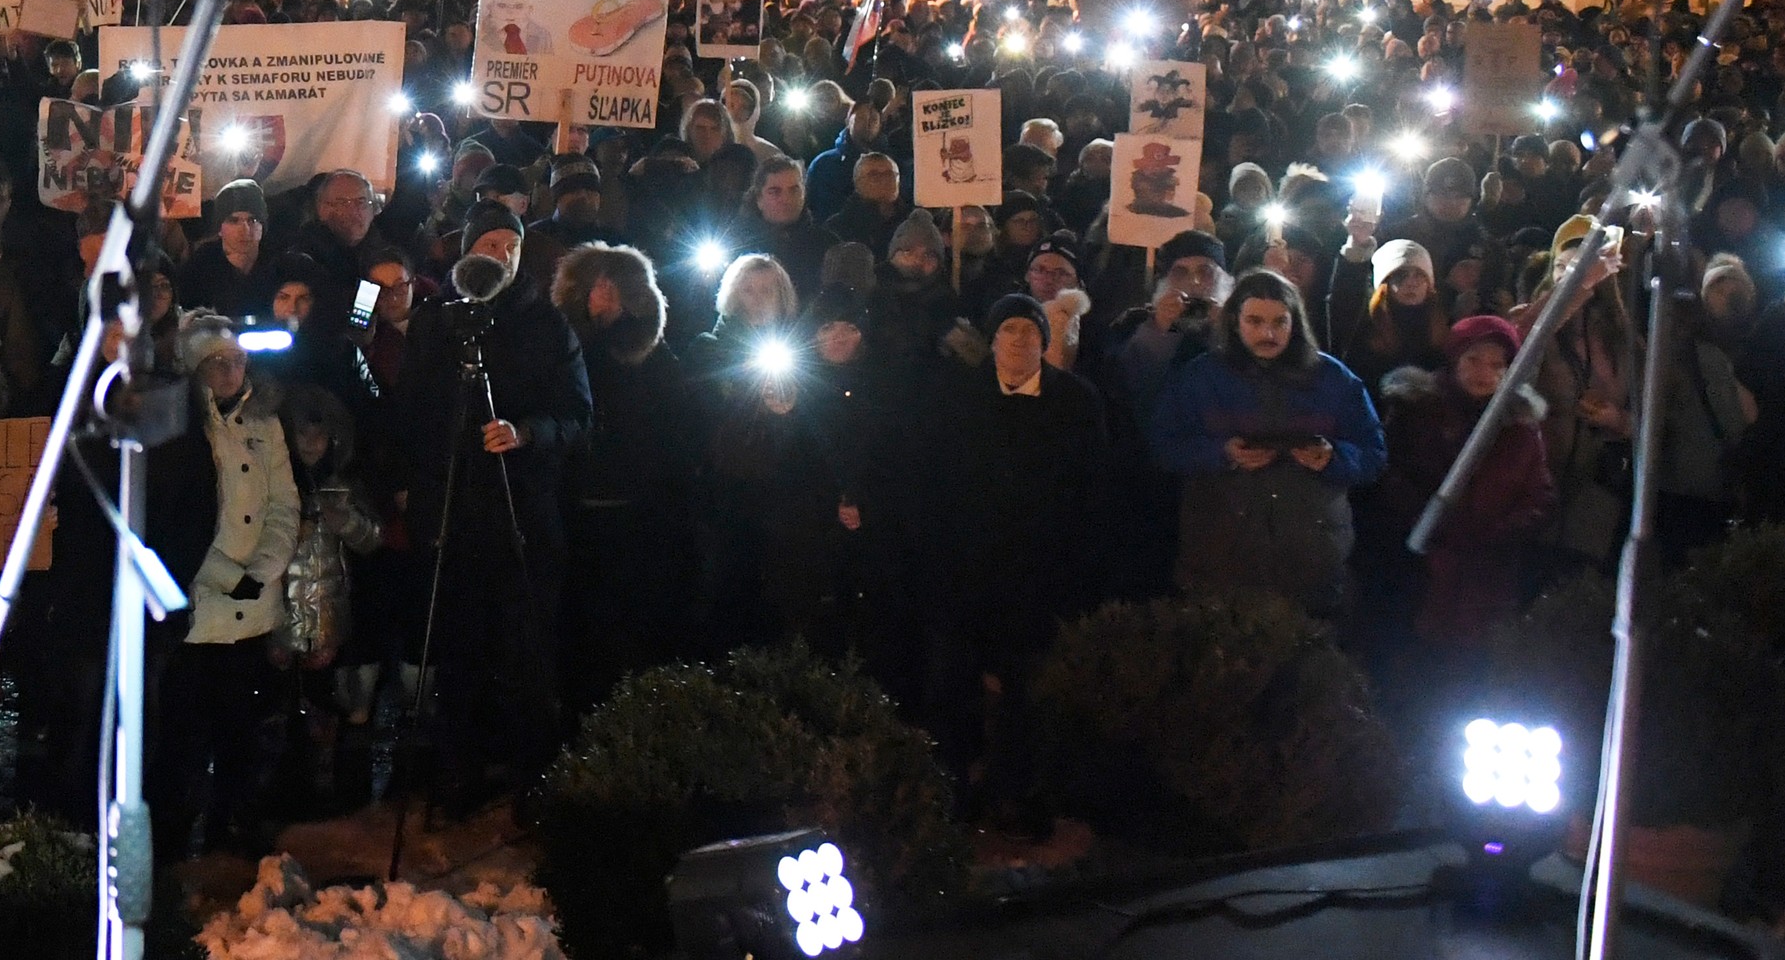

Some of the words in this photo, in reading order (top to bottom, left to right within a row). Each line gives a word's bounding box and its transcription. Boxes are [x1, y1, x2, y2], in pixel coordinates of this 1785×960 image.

[252, 56, 263, 67] A
[267, 51, 385, 68] ZMANIPULOVANÉ
[486, 57, 539, 80] PREMIÉR
[217, 74, 227, 85] K
[231, 71, 311, 86] SEMAFORU
[573, 63, 657, 88] PUTINOVA
[232, 89, 251, 102] SA
[254, 85, 327, 102] KAMARÁT
[481, 81, 531, 115] SR
[922, 98, 966, 116] KONIEC
